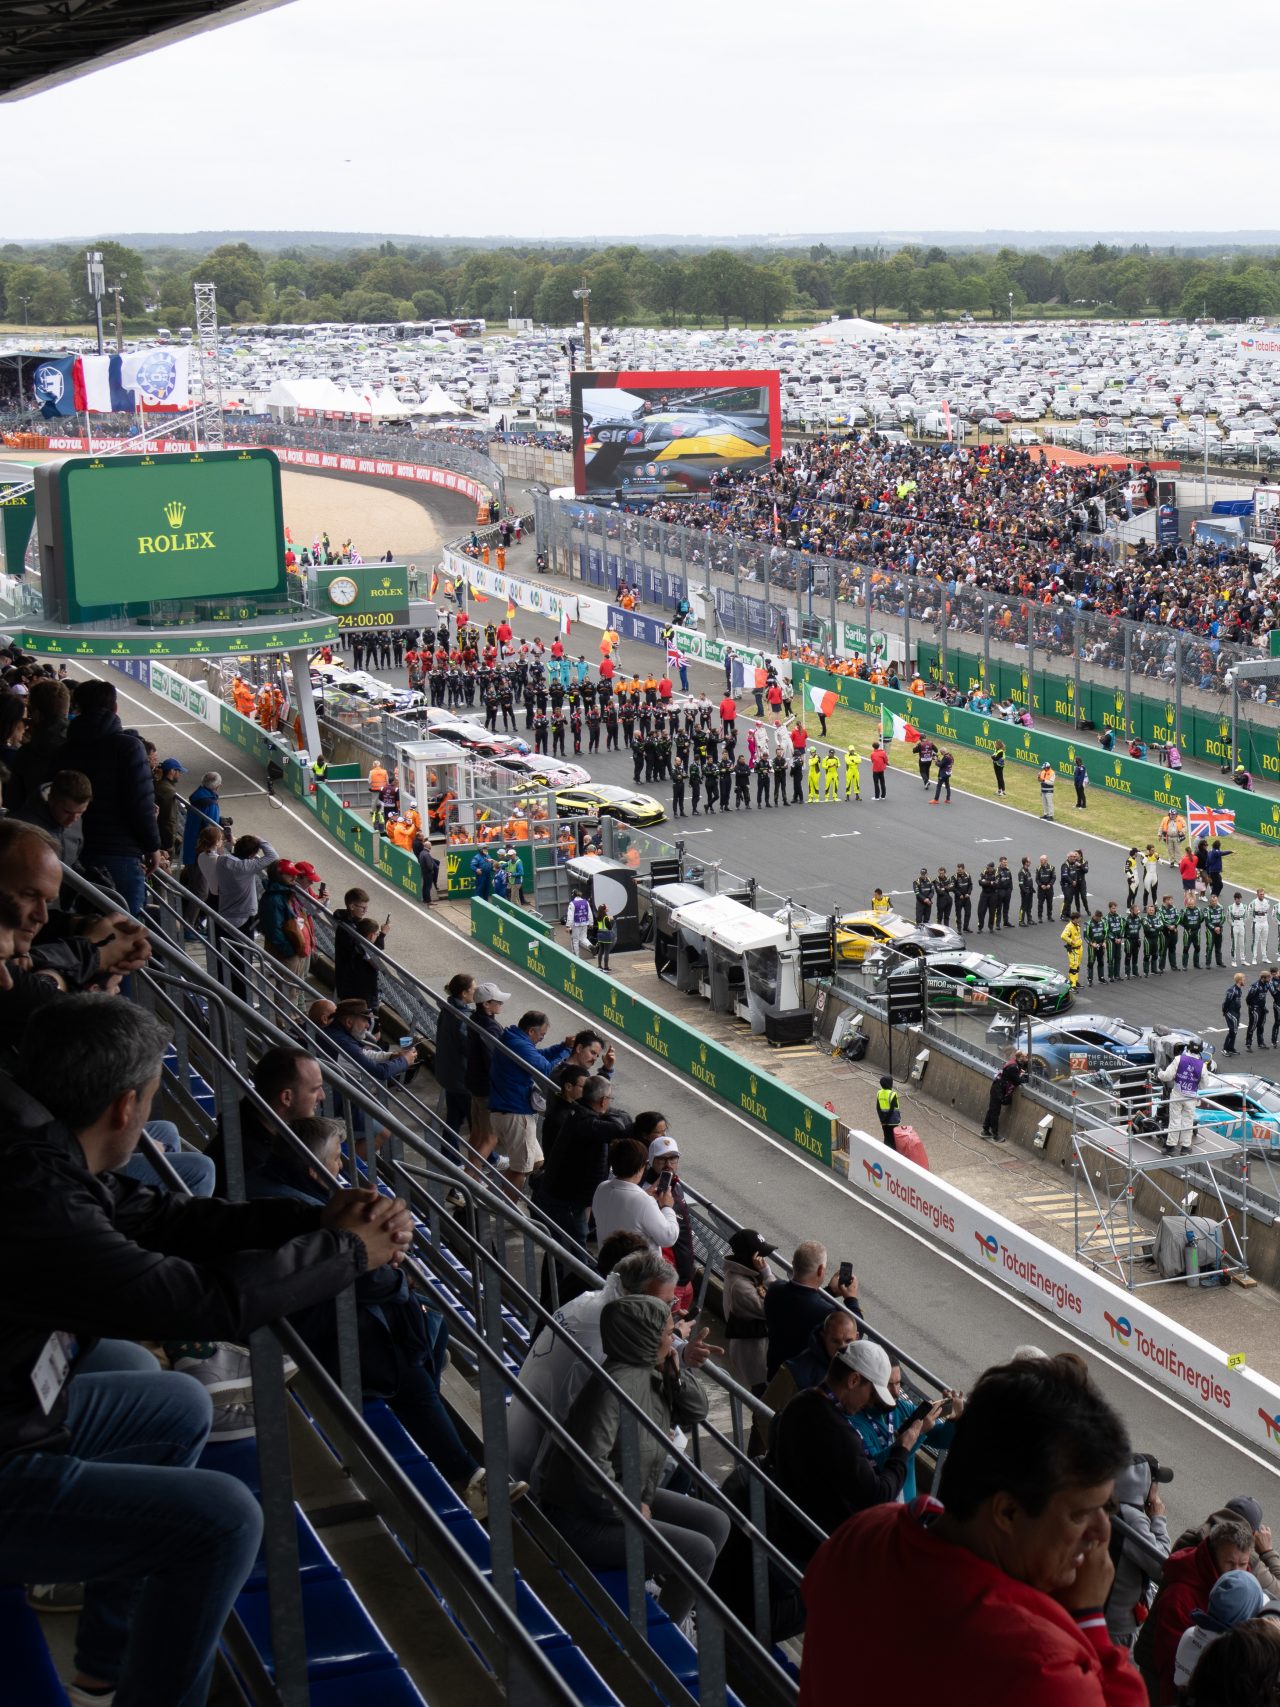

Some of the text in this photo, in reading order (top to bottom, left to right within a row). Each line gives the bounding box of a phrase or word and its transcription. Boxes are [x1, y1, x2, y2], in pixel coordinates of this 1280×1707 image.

[49, 438, 83, 450] MOTUL
[598, 429, 627, 443] elf
[138, 532, 216, 554] ROLEX
[371, 588, 403, 597] ROLEX
[337, 613, 394, 628] 24:00:00
[677, 632, 691, 646] Sarthe
[845, 624, 867, 643] Sarthe
[1011, 688, 1039, 708] ROLX
[936, 724, 958, 740] ROLEX
[1016, 748, 1040, 765] ROLEX
[1059, 760, 1076, 776] ROL
[1105, 775, 1132, 794] ROLEX
[1154, 789, 1183, 809] ROLEX
[402, 875, 417, 894] ROLEX
[492, 935, 511, 955] ROLEX
[527, 956, 546, 978] ROLEX
[563, 980, 584, 1003] ROLEX
[972, 991, 988, 1001] 777
[603, 1003, 625, 1029] ROLEX
[645, 1031, 669, 1058] ROLEX
[1070, 1058, 1086, 1070] 27
[691, 1060, 717, 1089] ROLEX
[741, 1092, 768, 1123] ROLEX
[794, 1127, 823, 1158] ROLEX
[885, 1172, 955, 1233] TotalEnergies
[1001, 1245, 1083, 1314] TotalEnergies
[1134, 1328, 1232, 1408] TotalEnergies
[1229, 1356, 1241, 1366] 93
